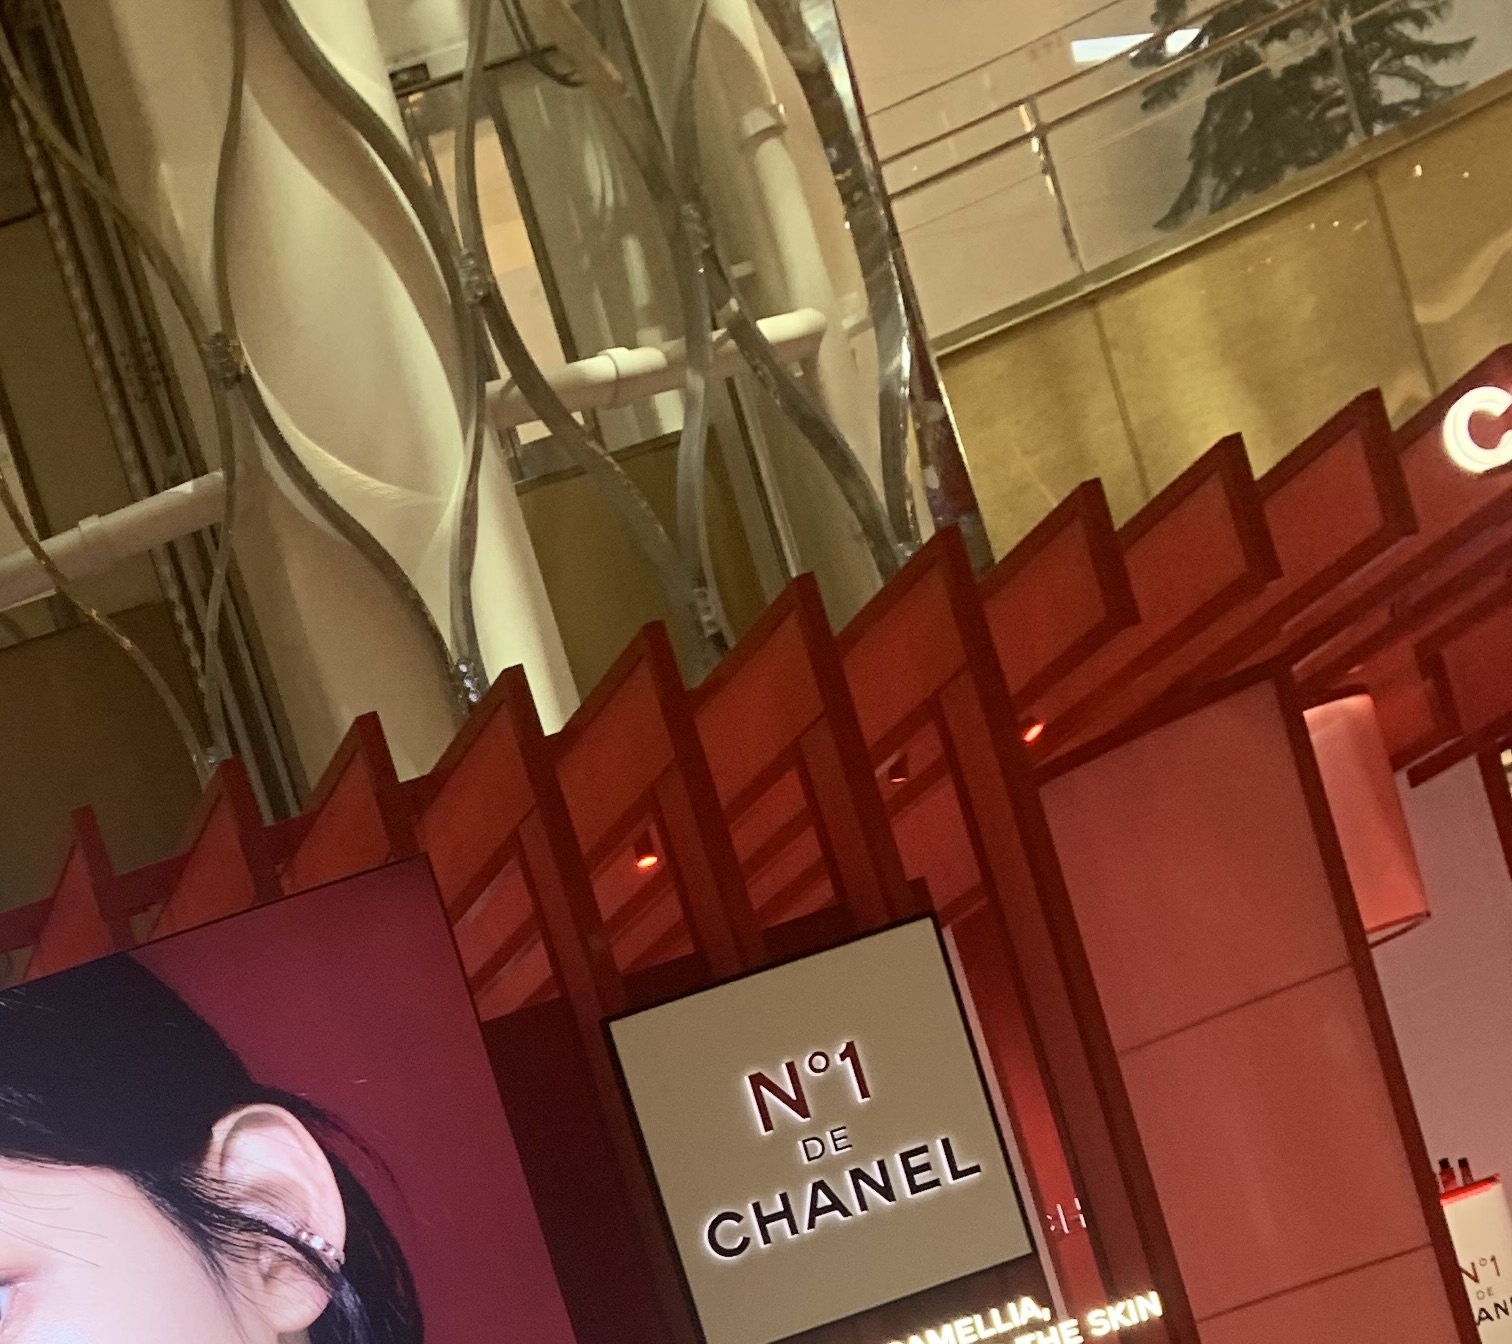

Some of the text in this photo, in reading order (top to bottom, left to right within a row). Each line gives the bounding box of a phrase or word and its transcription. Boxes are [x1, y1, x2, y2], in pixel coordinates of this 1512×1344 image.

[745, 1039, 872, 1136] N°1
[798, 1125, 852, 1163] DE
[703, 1137, 982, 1259] CHANEL
[1087, 1291, 1163, 1339] SKIN
